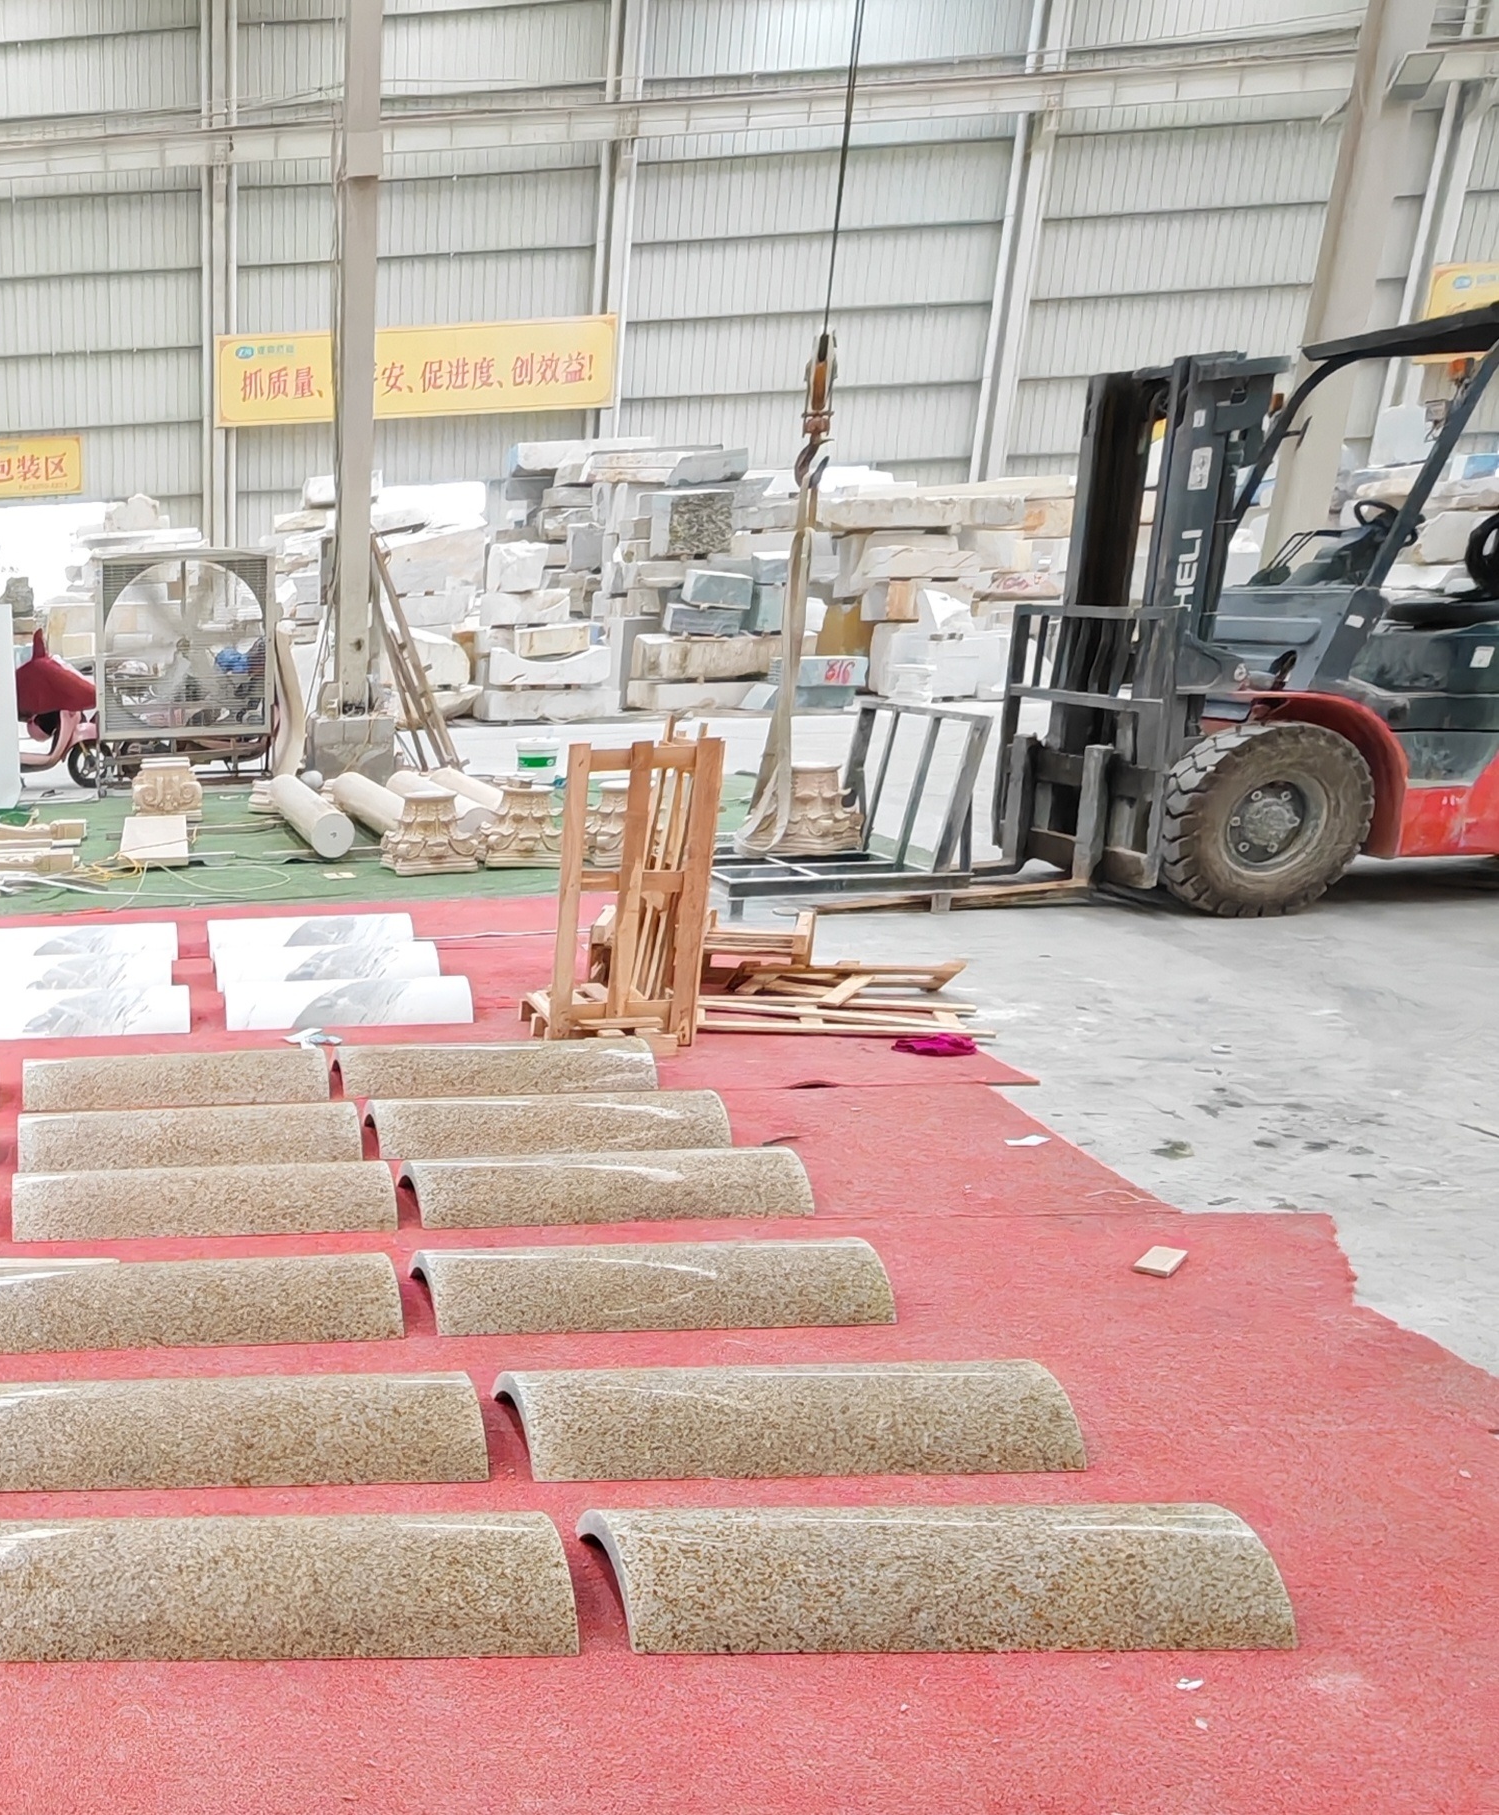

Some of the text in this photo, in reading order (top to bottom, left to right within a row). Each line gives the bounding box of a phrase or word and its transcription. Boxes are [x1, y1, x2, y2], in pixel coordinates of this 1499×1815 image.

[240, 350, 595, 403] 抓质量、安、促进度、创效益!
[1173, 528, 1204, 613] HELI
